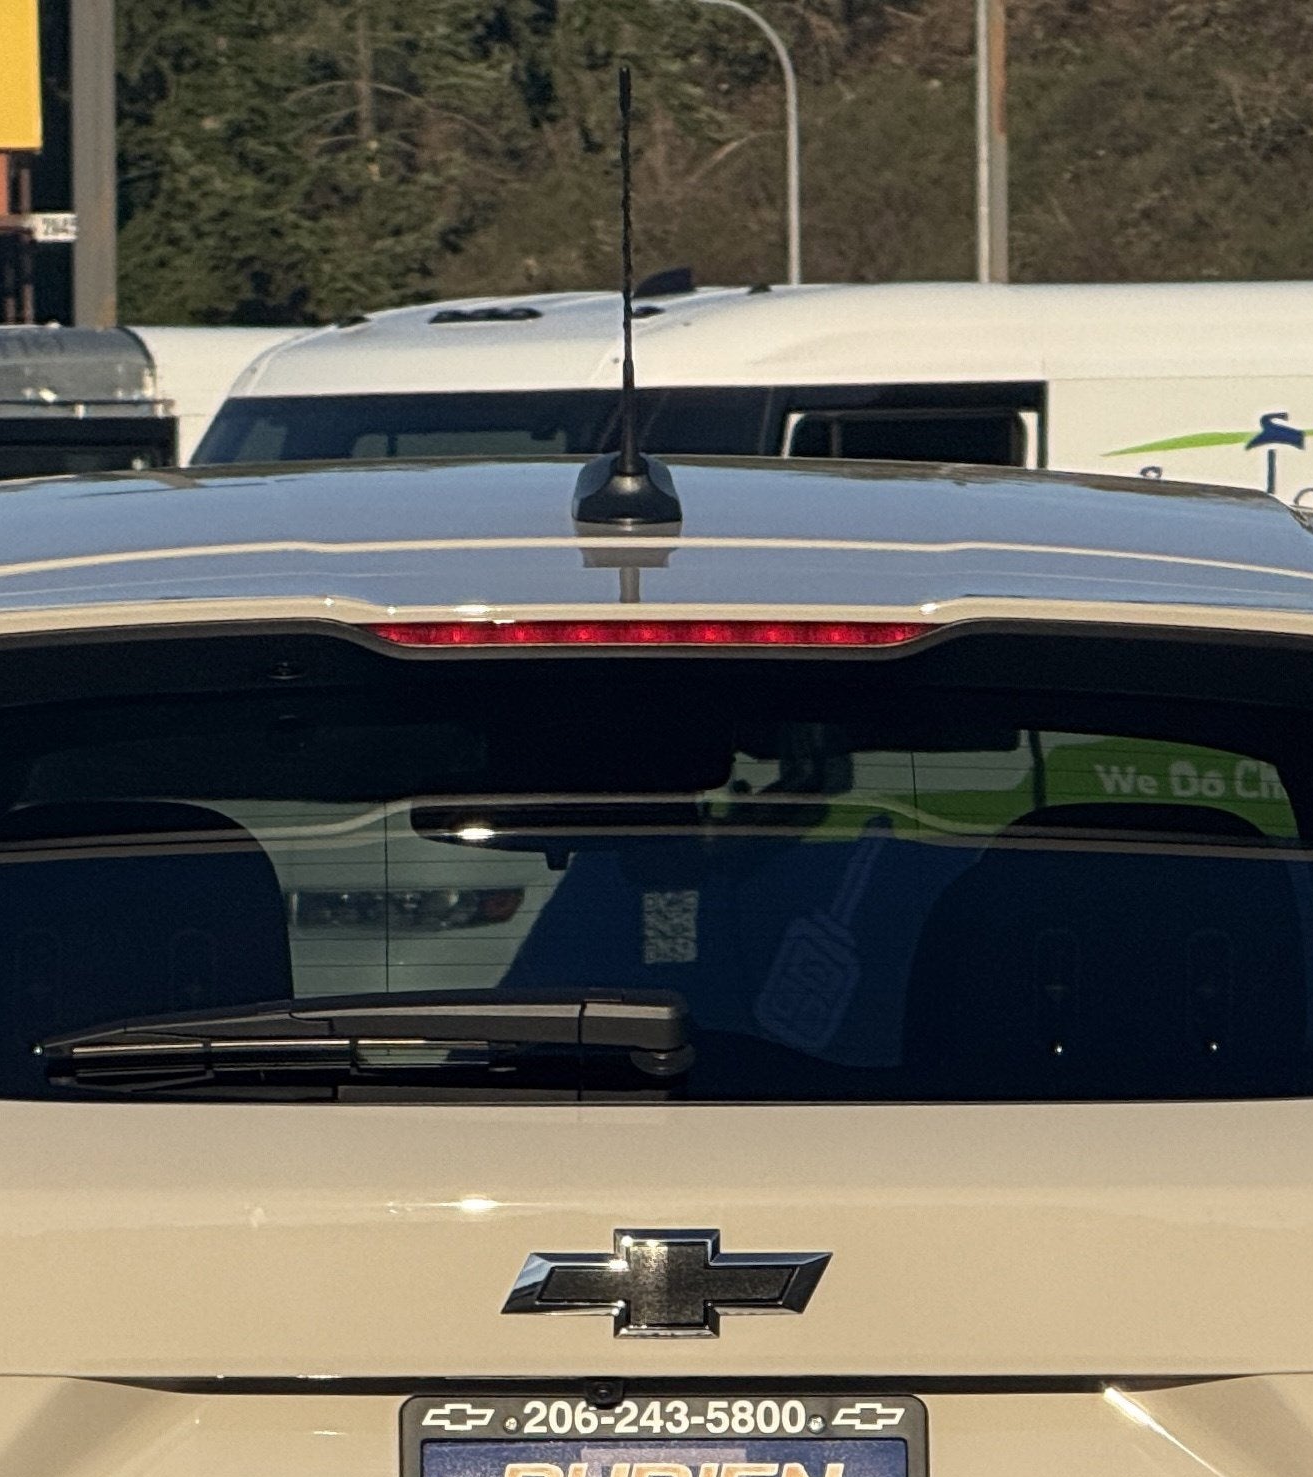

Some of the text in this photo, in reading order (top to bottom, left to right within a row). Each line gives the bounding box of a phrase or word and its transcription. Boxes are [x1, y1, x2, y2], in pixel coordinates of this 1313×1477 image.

[1093, 763, 1159, 795] We
[1169, 760, 1226, 798] Do
[523, 1400, 806, 1435] 206-243-5800
